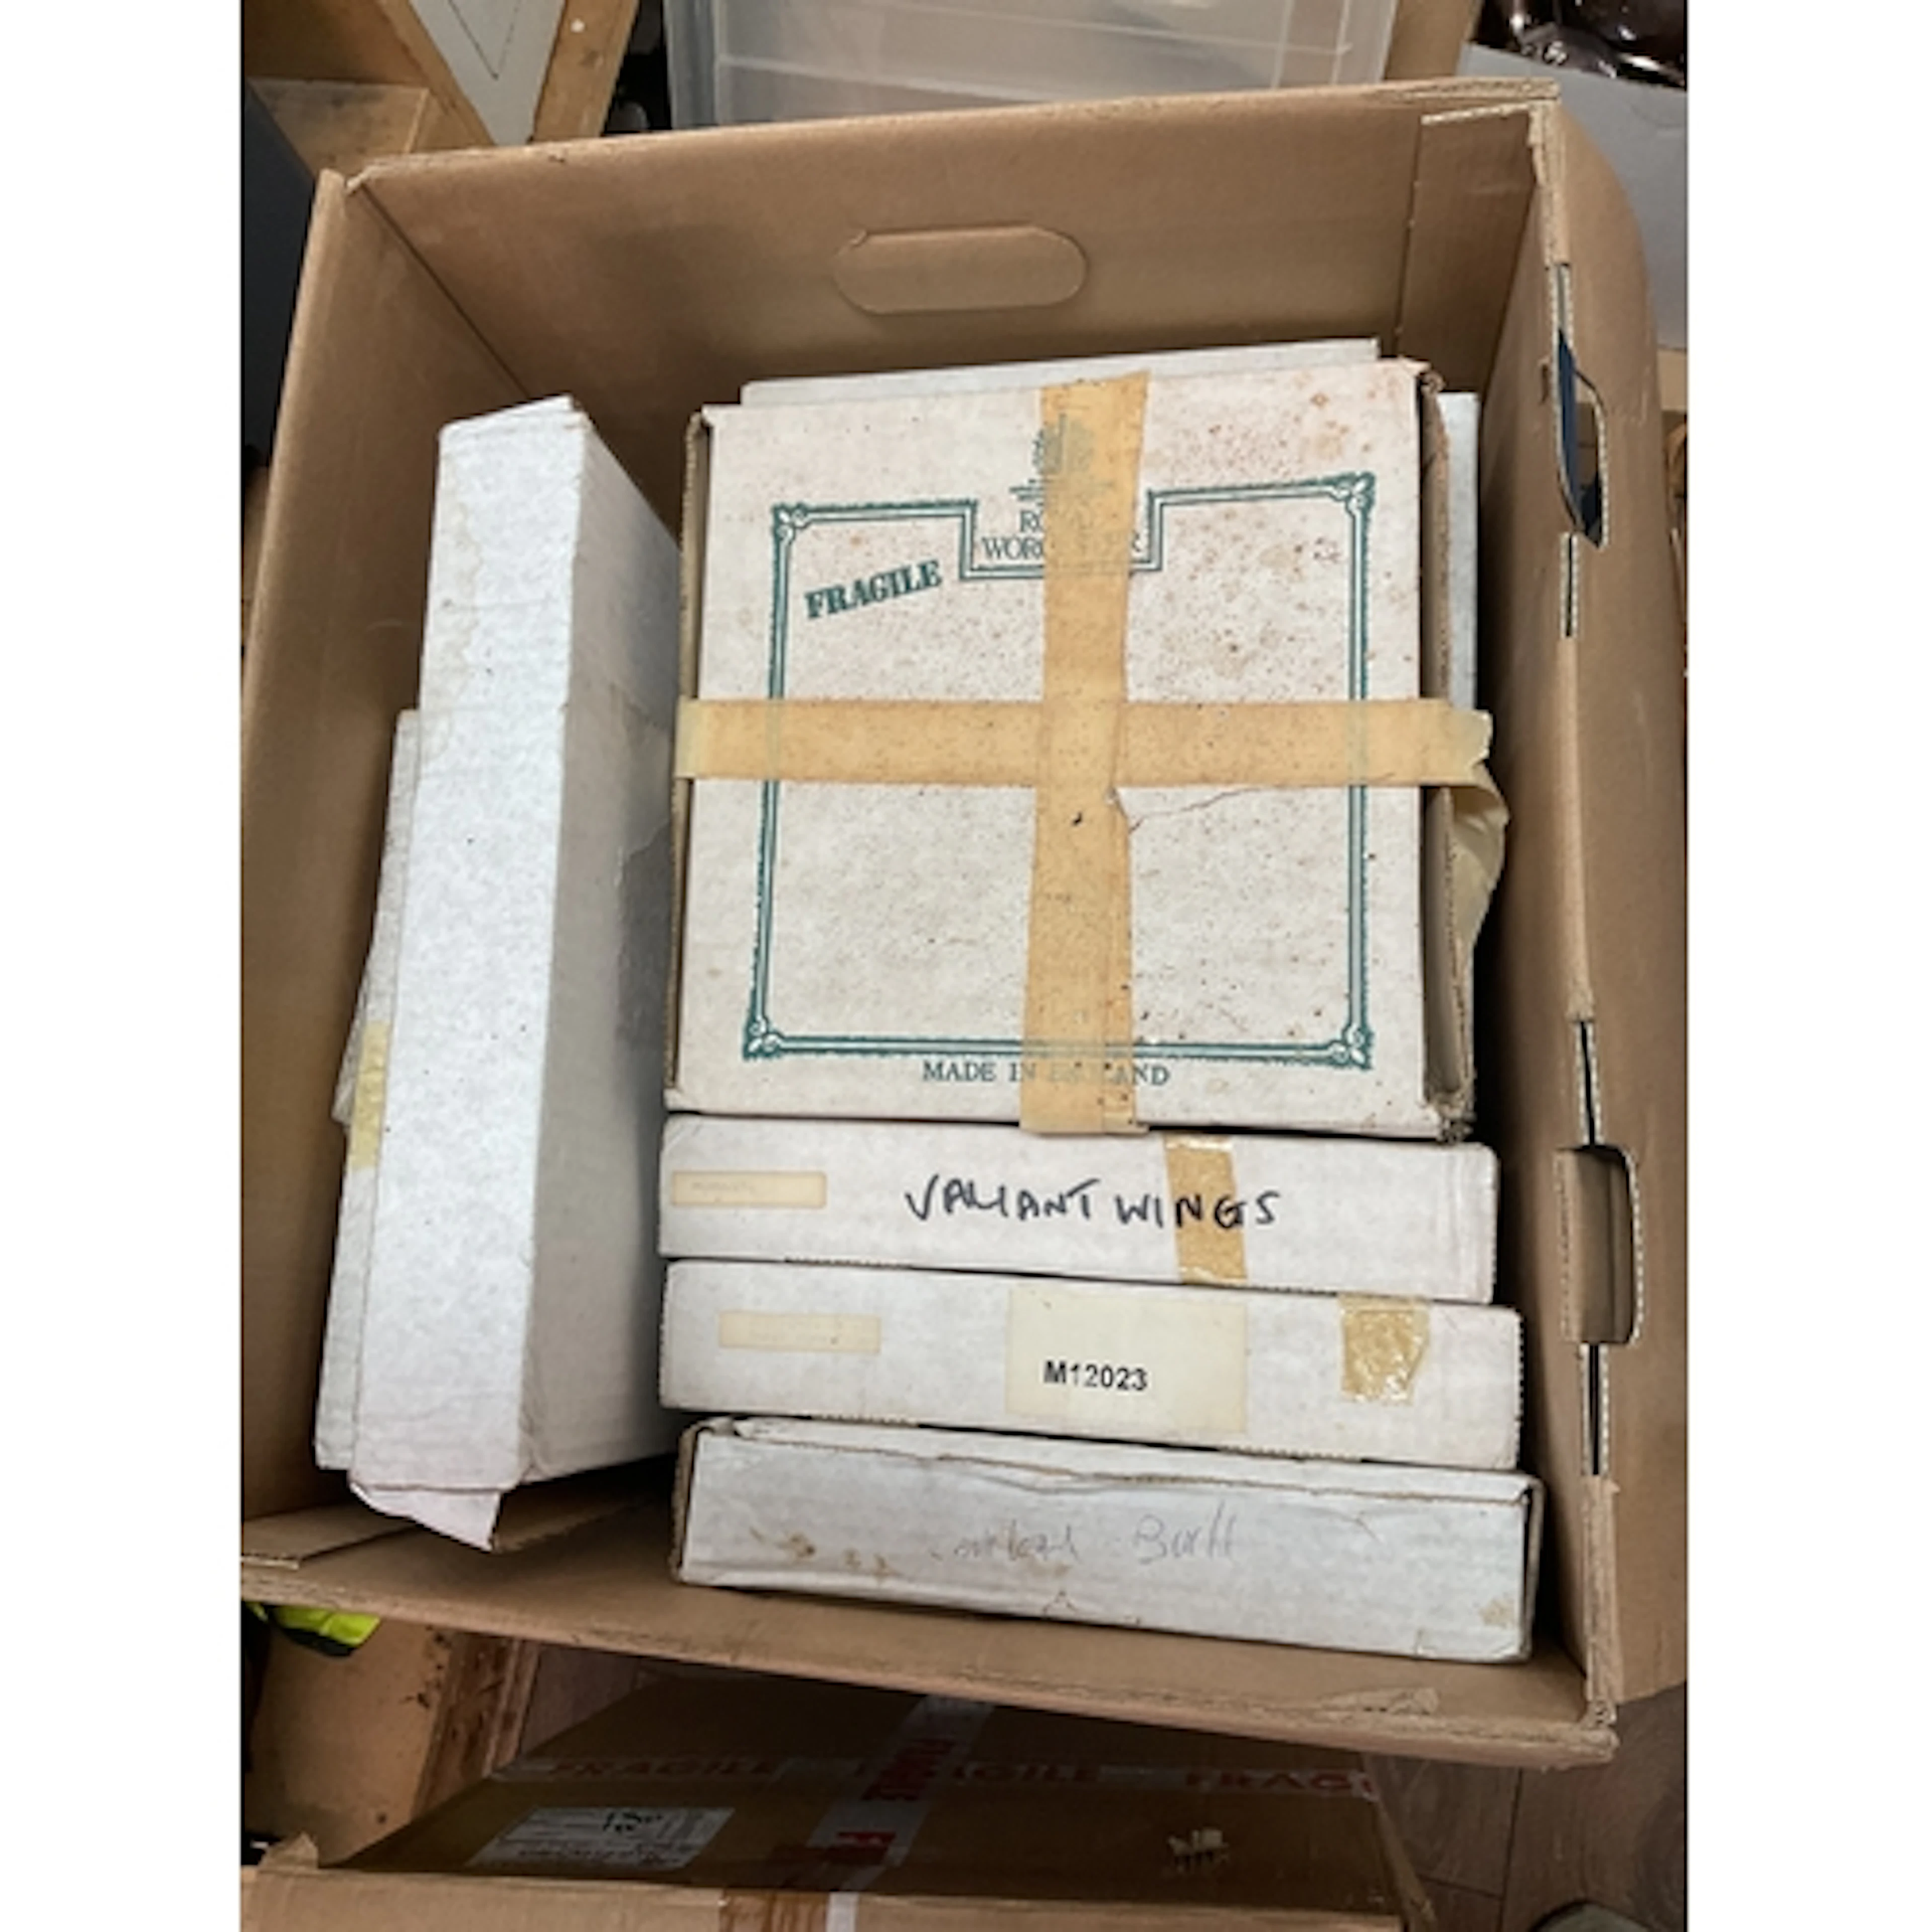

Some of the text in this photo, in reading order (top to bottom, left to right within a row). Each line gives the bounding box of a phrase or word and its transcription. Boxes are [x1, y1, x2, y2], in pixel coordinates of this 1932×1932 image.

[804, 560, 942, 618] FRAGILE
[922, 1061, 995, 1081] MADE
[1008, 1062, 1035, 1082] IN
[905, 1174, 1280, 1229] VALIANT WINGS
[1043, 1360, 1147, 1391] M12023
